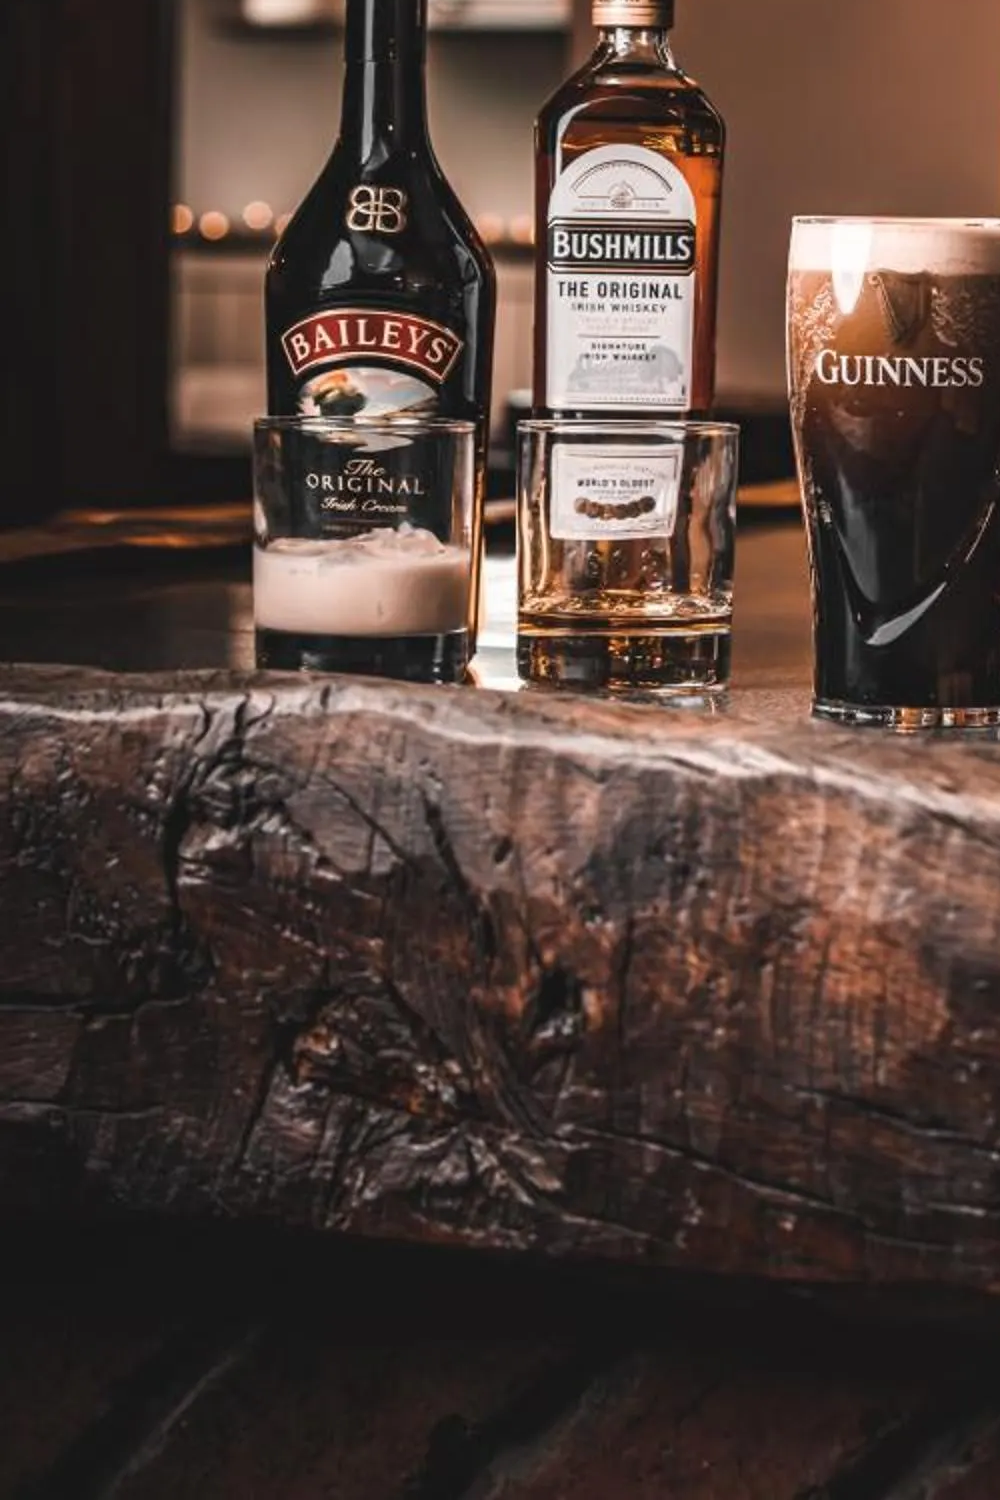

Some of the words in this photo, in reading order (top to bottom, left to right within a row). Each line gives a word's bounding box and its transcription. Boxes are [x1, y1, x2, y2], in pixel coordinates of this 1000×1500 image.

[553, 230, 691, 261] BUSHMILLS
[558, 281, 589, 298] THE
[597, 282, 683, 299] ORIGINAL
[571, 303, 605, 312] IRISH
[610, 303, 667, 314] WHISKEY
[290, 318, 448, 364] BAILEYS
[814, 349, 984, 387] GUINNESS
[343, 459, 386, 477] The
[306, 472, 425, 495] ORIGINAL
